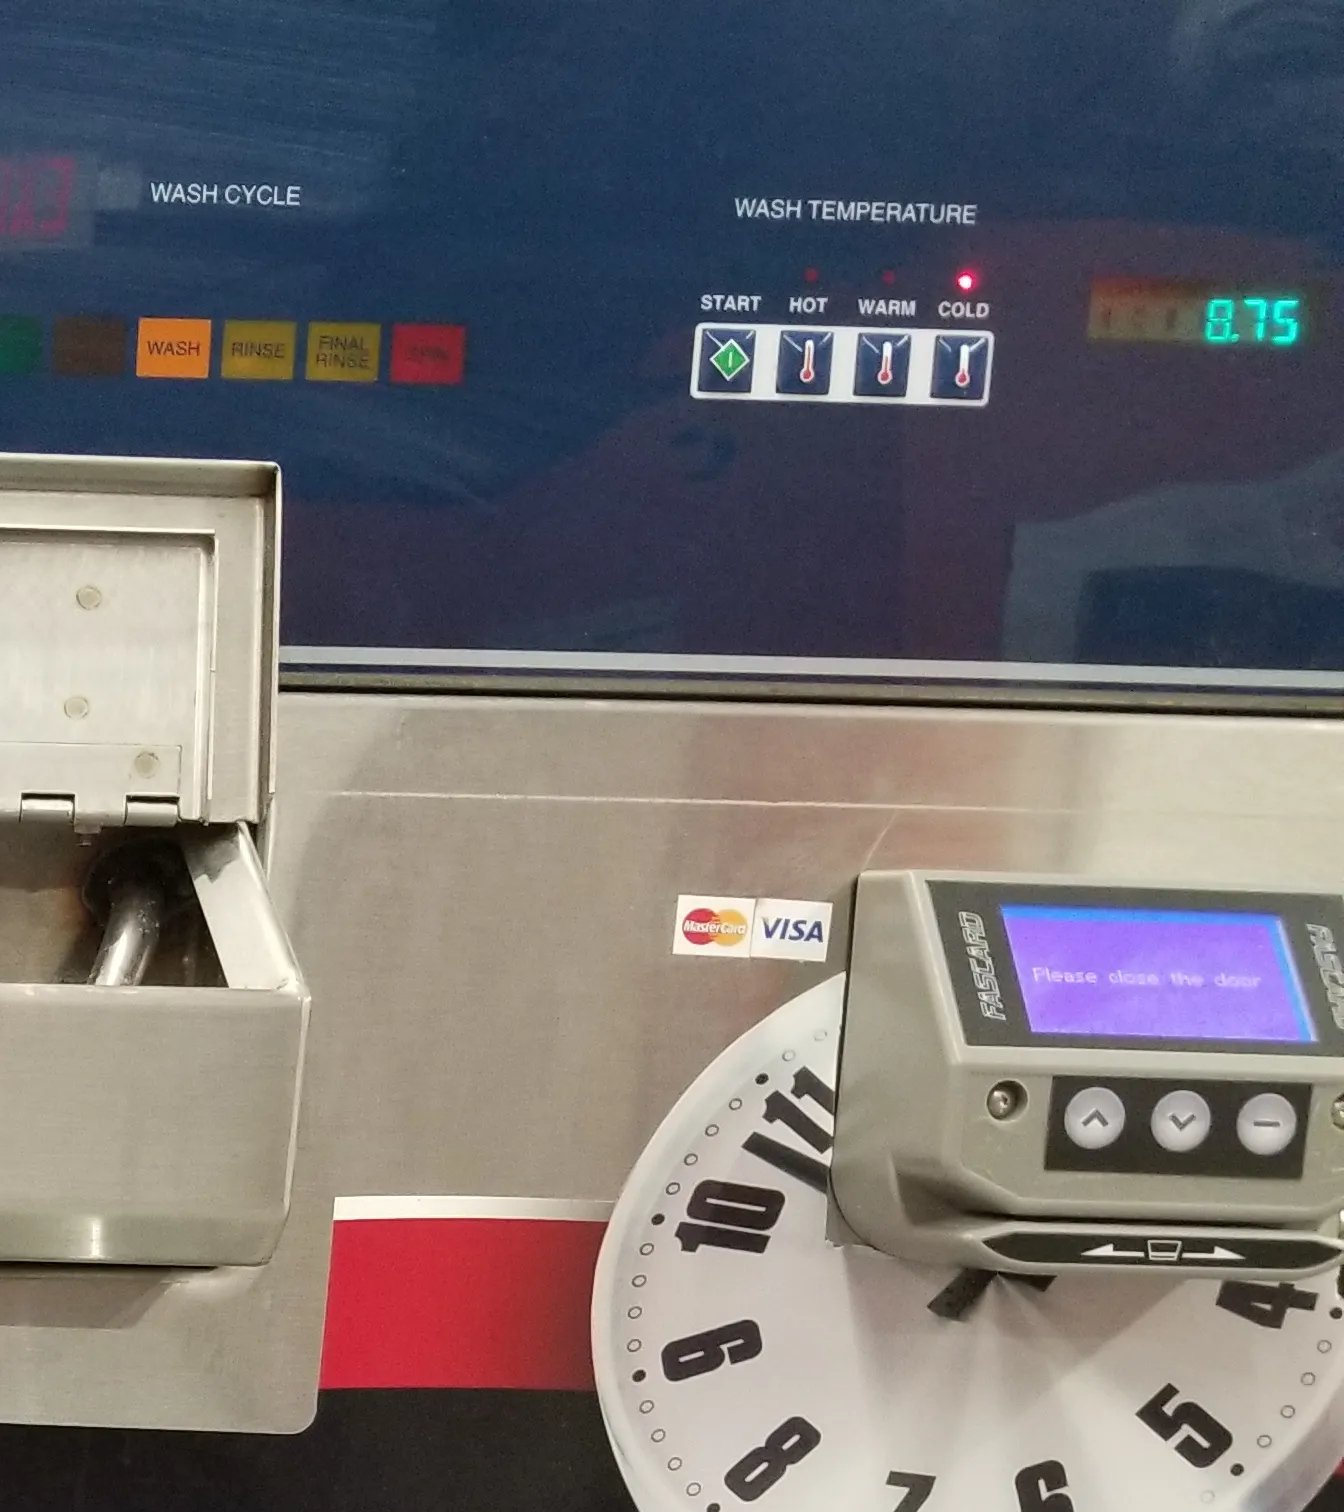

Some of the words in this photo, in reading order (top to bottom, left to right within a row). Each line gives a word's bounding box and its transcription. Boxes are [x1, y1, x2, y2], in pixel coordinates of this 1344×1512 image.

[150, 182, 218, 204] WASH
[225, 184, 301, 206] CYCLE
[734, 197, 801, 219] WASH
[808, 200, 976, 225] TEMPERATURE
[700, 295, 760, 311] START
[789, 297, 827, 313] HOT
[857, 299, 915, 315] WARM
[938, 301, 990, 319] COLD
[1205, 298, 1300, 344] 8.75
[147, 340, 200, 357] WASH
[232, 342, 285, 358] RINSE
[684, 919, 746, 935] MasterCard
[762, 917, 823, 943] VISA
[1033, 967, 1097, 984] Please
[1109, 969, 1160, 986] close
[1170, 970, 1204, 987] the
[1214, 973, 1261, 989] door
[675, 1179, 785, 1252] 10
[1136, 1383, 1232, 1468] 5
